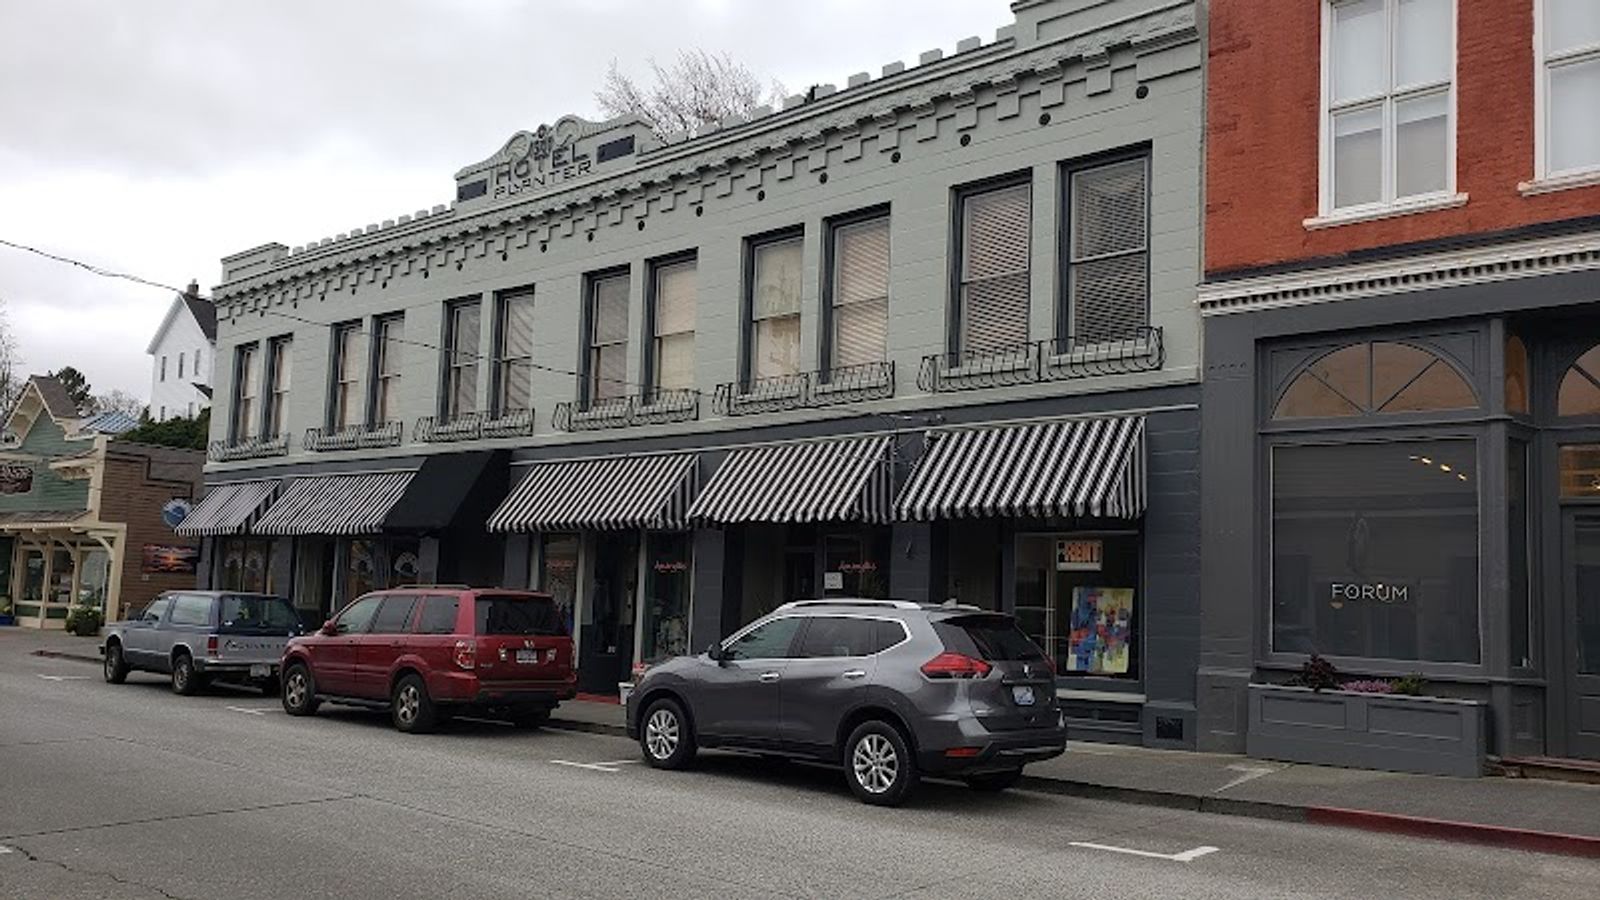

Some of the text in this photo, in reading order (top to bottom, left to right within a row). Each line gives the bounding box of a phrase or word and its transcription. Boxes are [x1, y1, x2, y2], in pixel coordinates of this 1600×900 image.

[493, 159, 592, 199] PLANTER
[496, 143, 590, 185] HOTEL
[1331, 583, 1408, 601] FORUM
